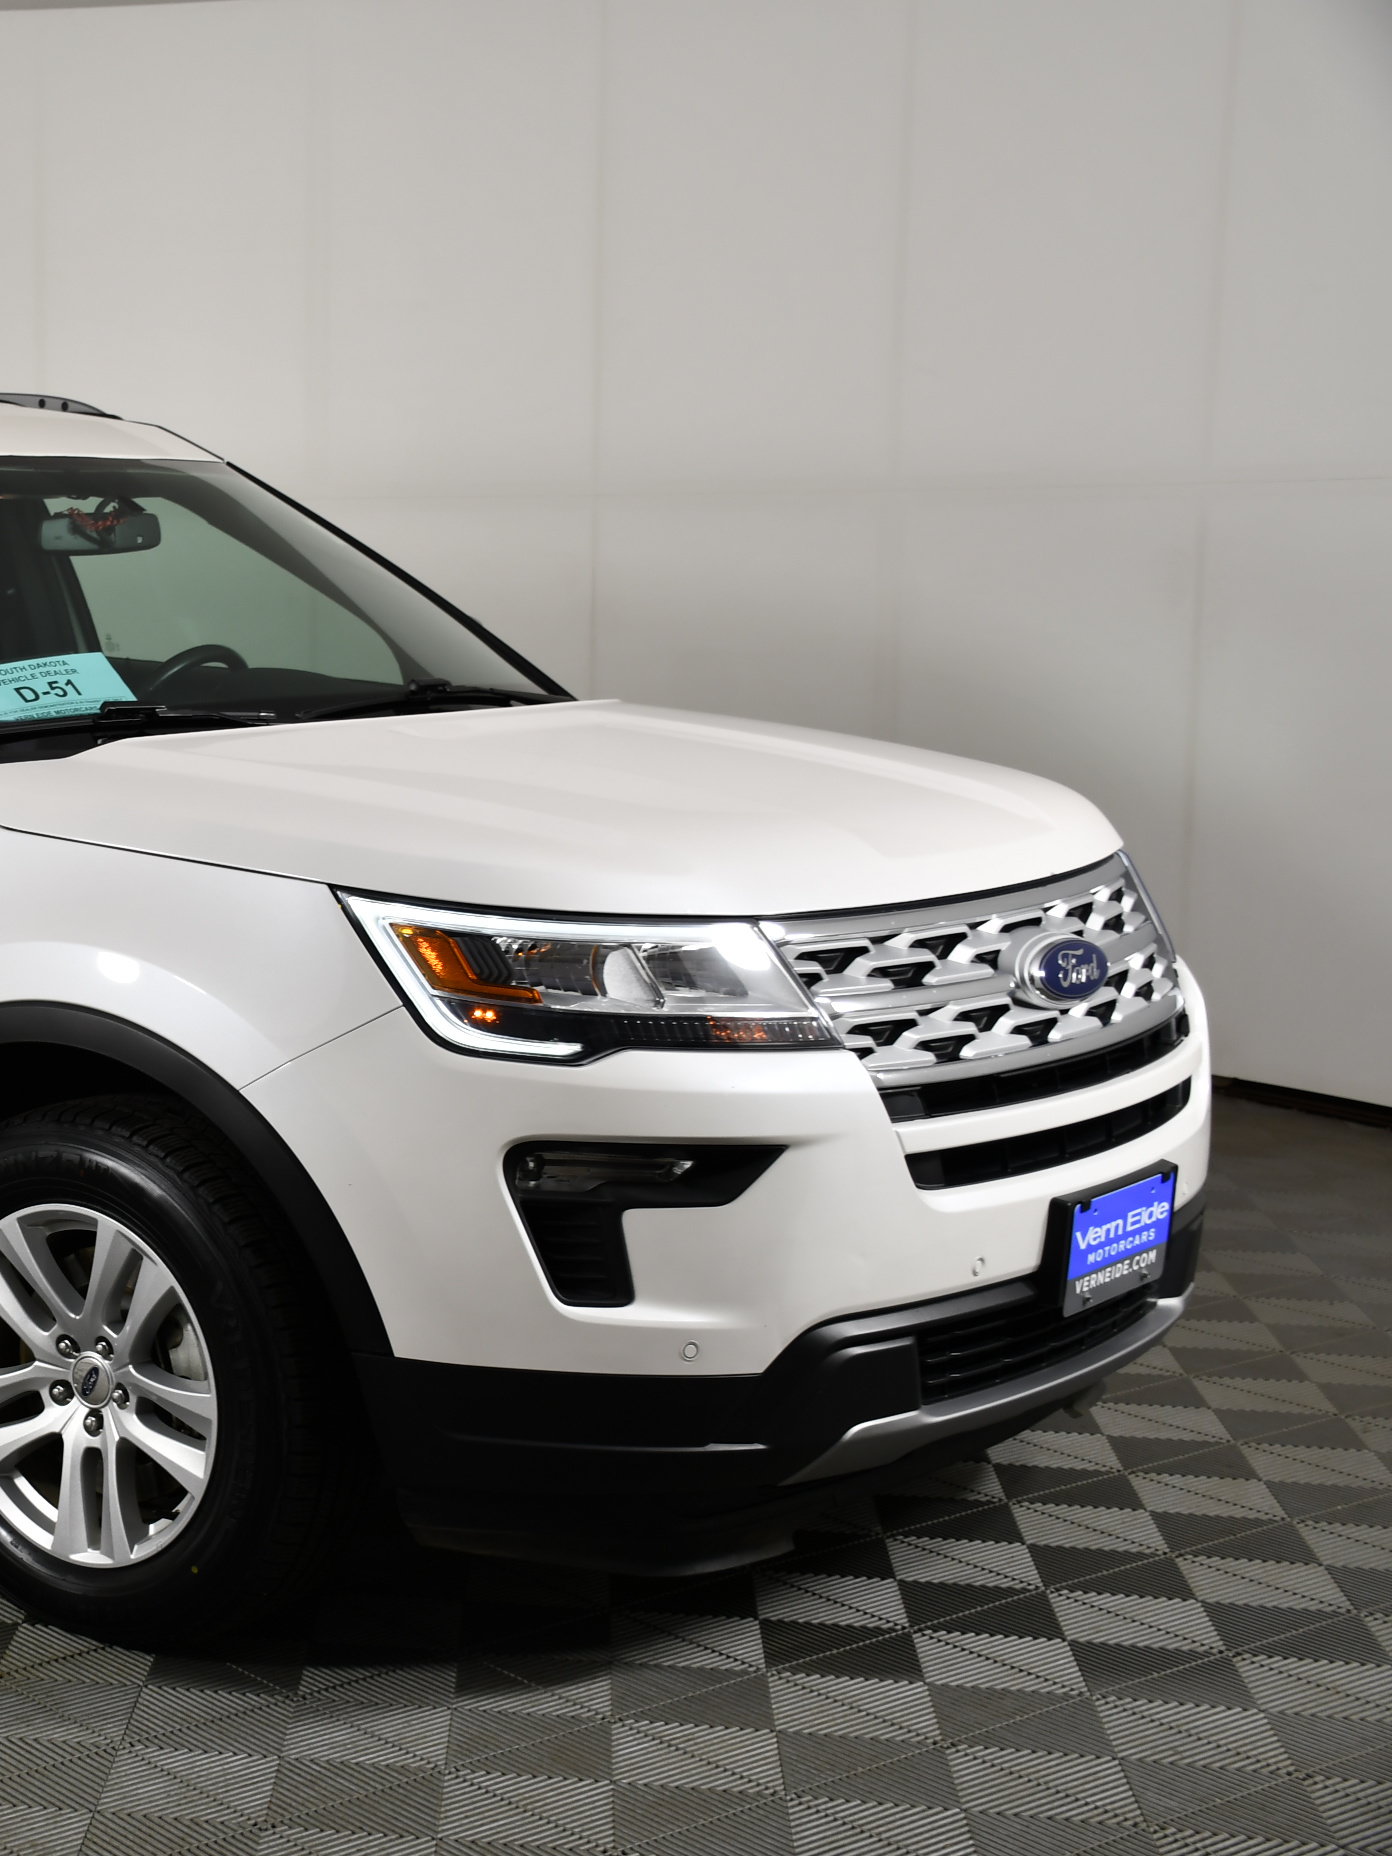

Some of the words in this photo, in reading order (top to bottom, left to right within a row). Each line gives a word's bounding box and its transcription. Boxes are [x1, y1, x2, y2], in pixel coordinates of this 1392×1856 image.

[28, 660, 70, 670] DAKOTA
[39, 668, 79, 678] DEALER
[14, 679, 82, 703] D-51
[1058, 948, 1100, 988] Ford
[1075, 1218, 1124, 1250] Vern
[1126, 1201, 1170, 1232] Eide
[1087, 1228, 1157, 1265] MOTORCARS
[1075, 1249, 1157, 1295] VERNEIDE.COM
